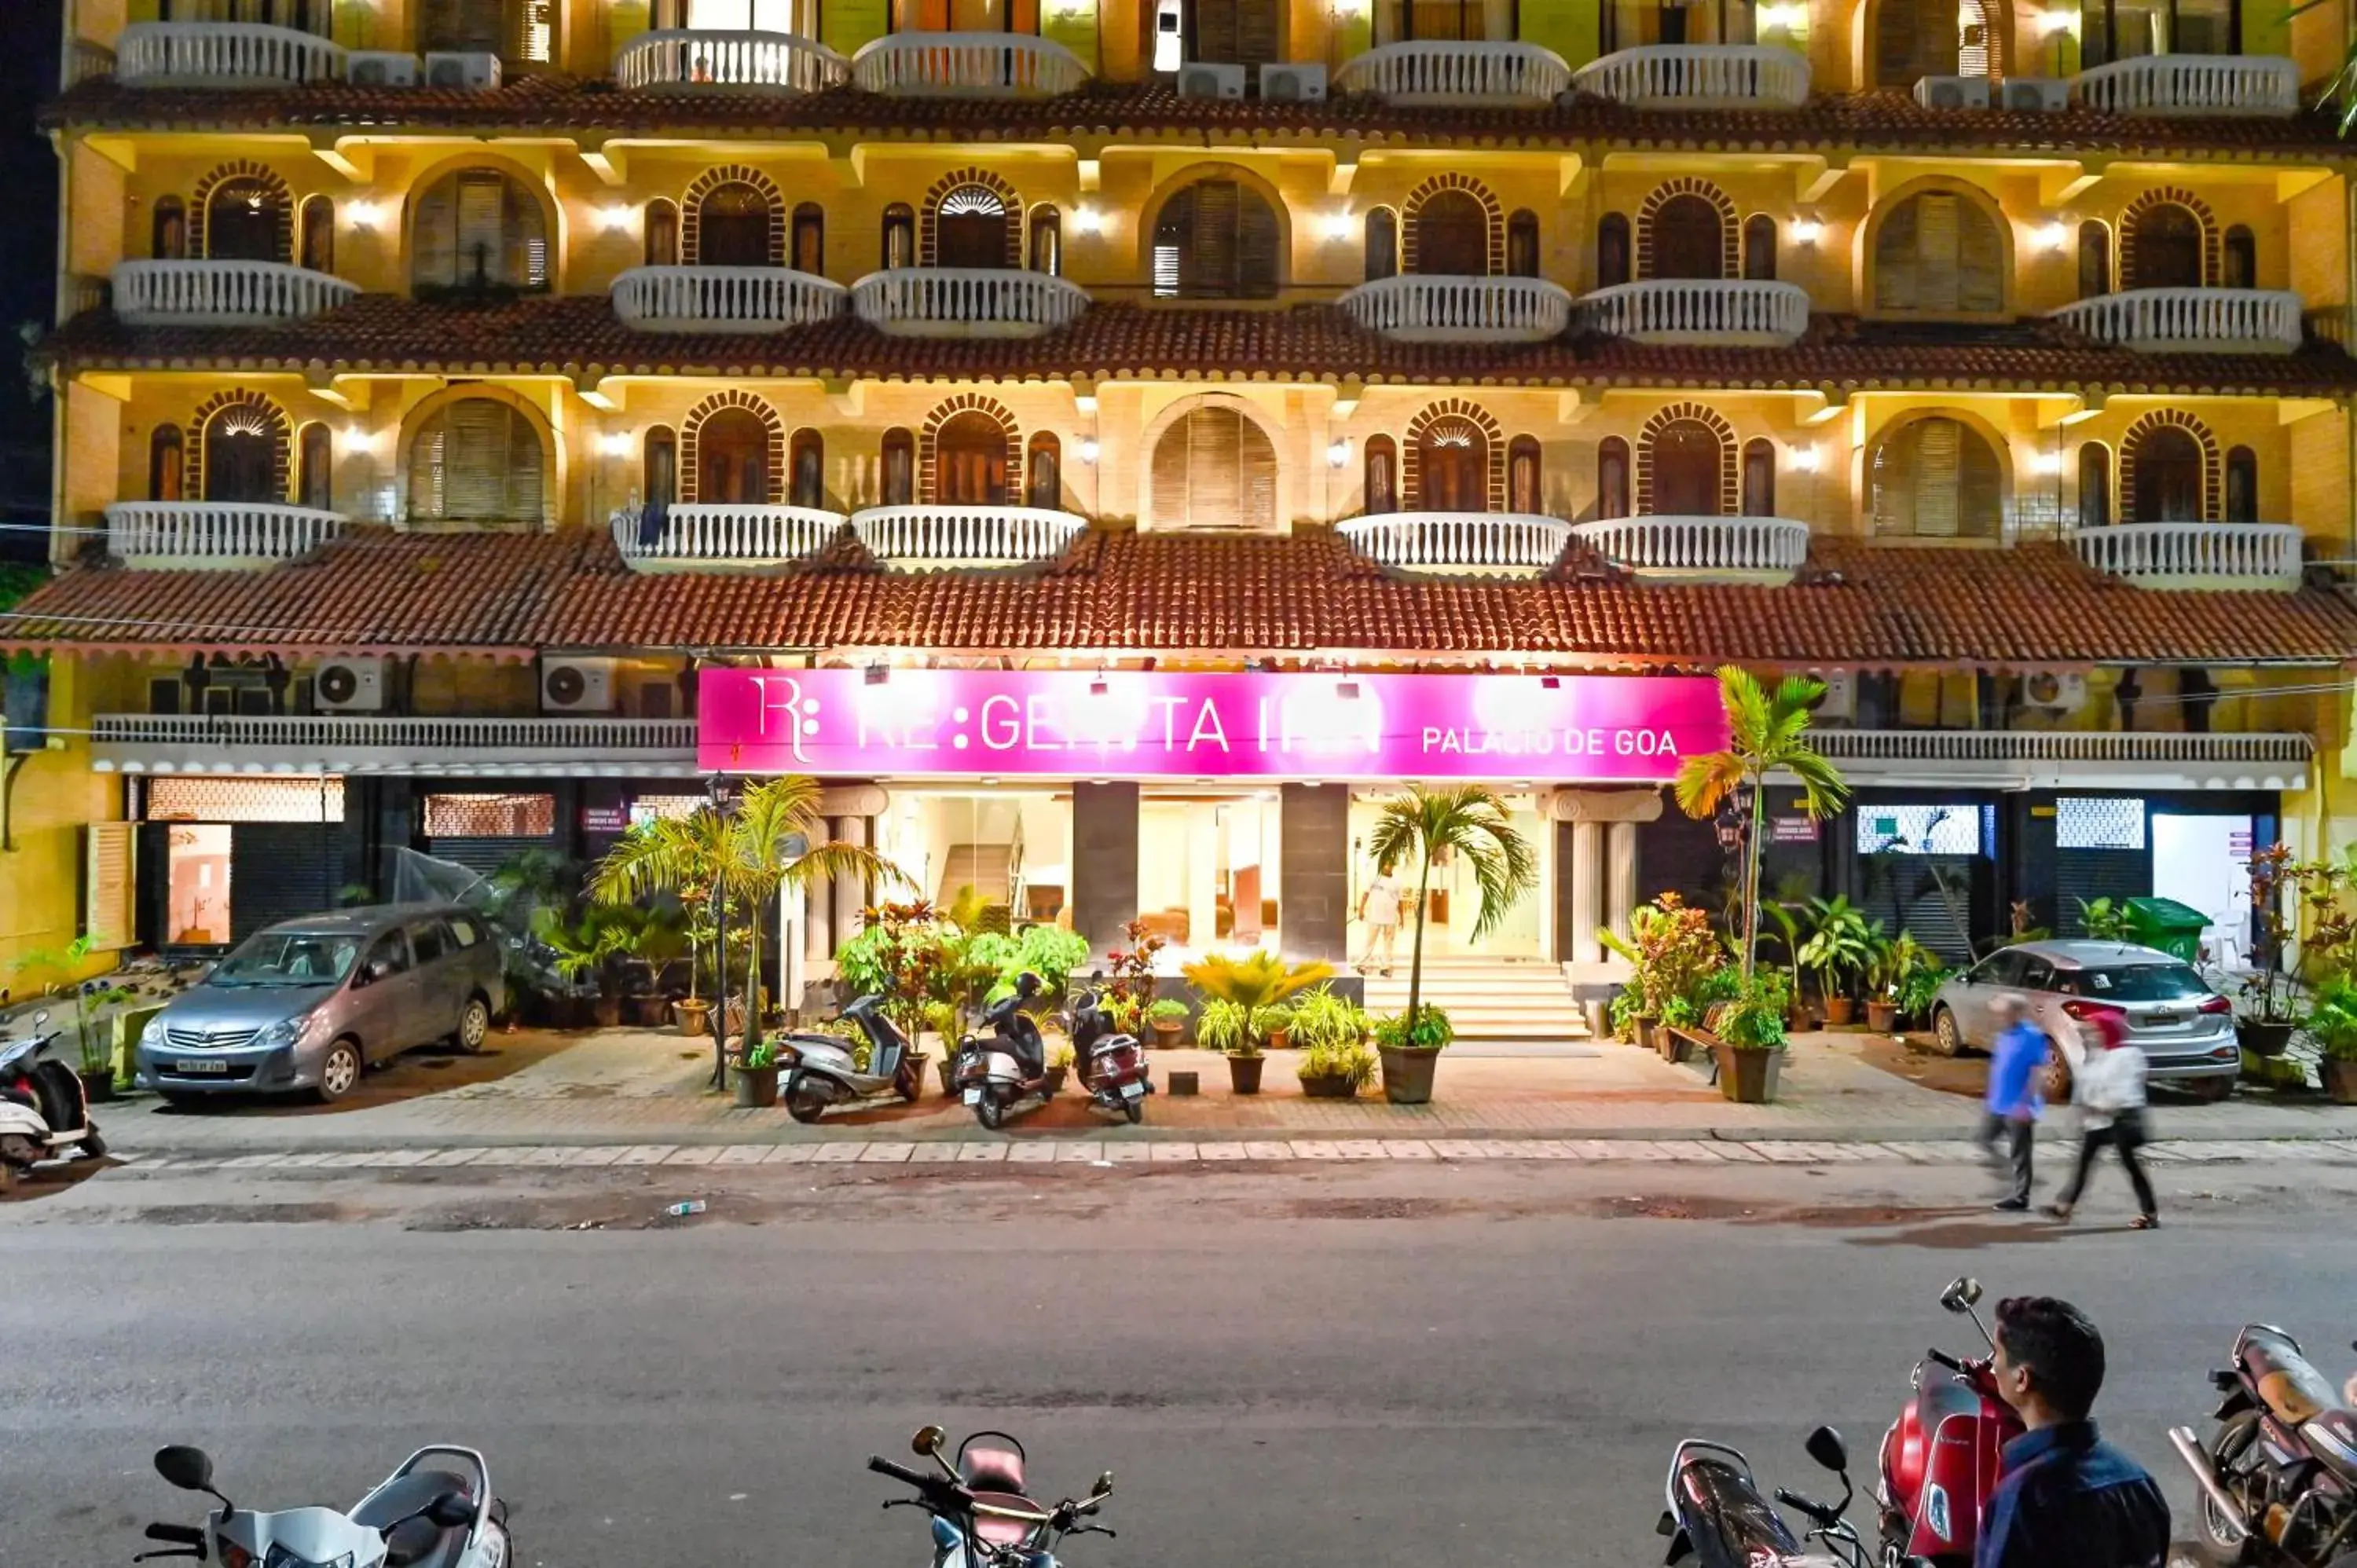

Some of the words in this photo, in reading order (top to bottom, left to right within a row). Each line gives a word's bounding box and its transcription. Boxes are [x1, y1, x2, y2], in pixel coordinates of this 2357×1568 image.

[857, 694, 1230, 753] RE:GETA
[1421, 727, 1555, 755] PALACIO
[1564, 729, 1605, 755] DE
[1614, 728, 1678, 756] GOA
